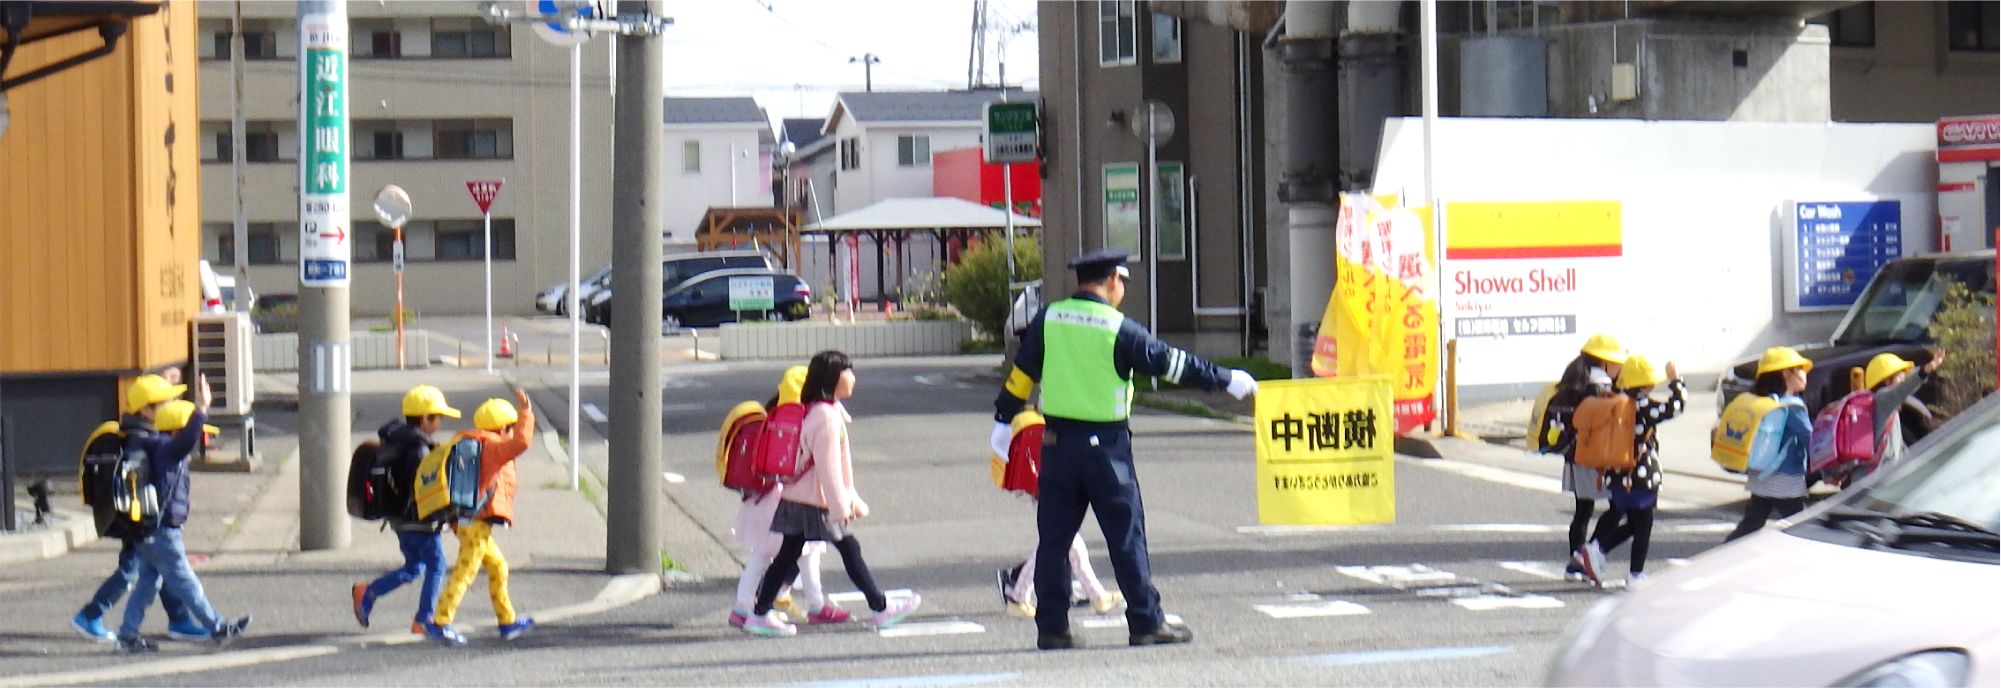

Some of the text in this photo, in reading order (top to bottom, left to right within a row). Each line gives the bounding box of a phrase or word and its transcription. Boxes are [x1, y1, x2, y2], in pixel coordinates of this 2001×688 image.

[316, 53, 340, 189] 近江眼科
[1455, 267, 1576, 295] Showa Shell
